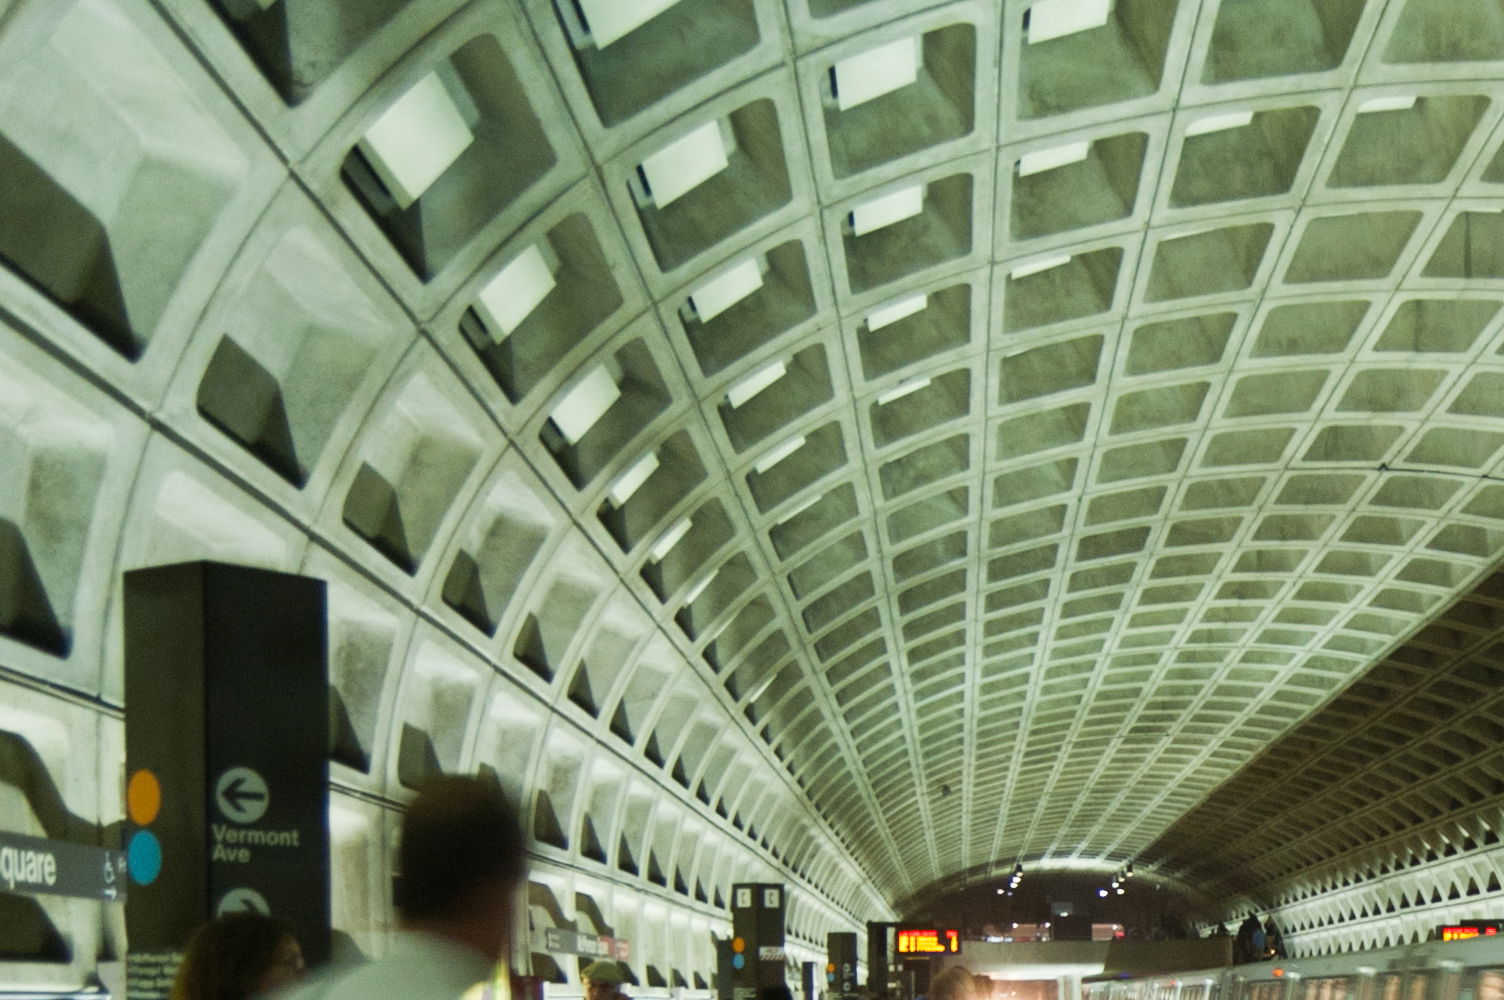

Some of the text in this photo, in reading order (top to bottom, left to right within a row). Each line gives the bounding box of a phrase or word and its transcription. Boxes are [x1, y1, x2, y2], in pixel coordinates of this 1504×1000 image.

[212, 824, 299, 847] Vermont
[212, 844, 251, 863] Ave
[0, 846, 57, 890] quare
